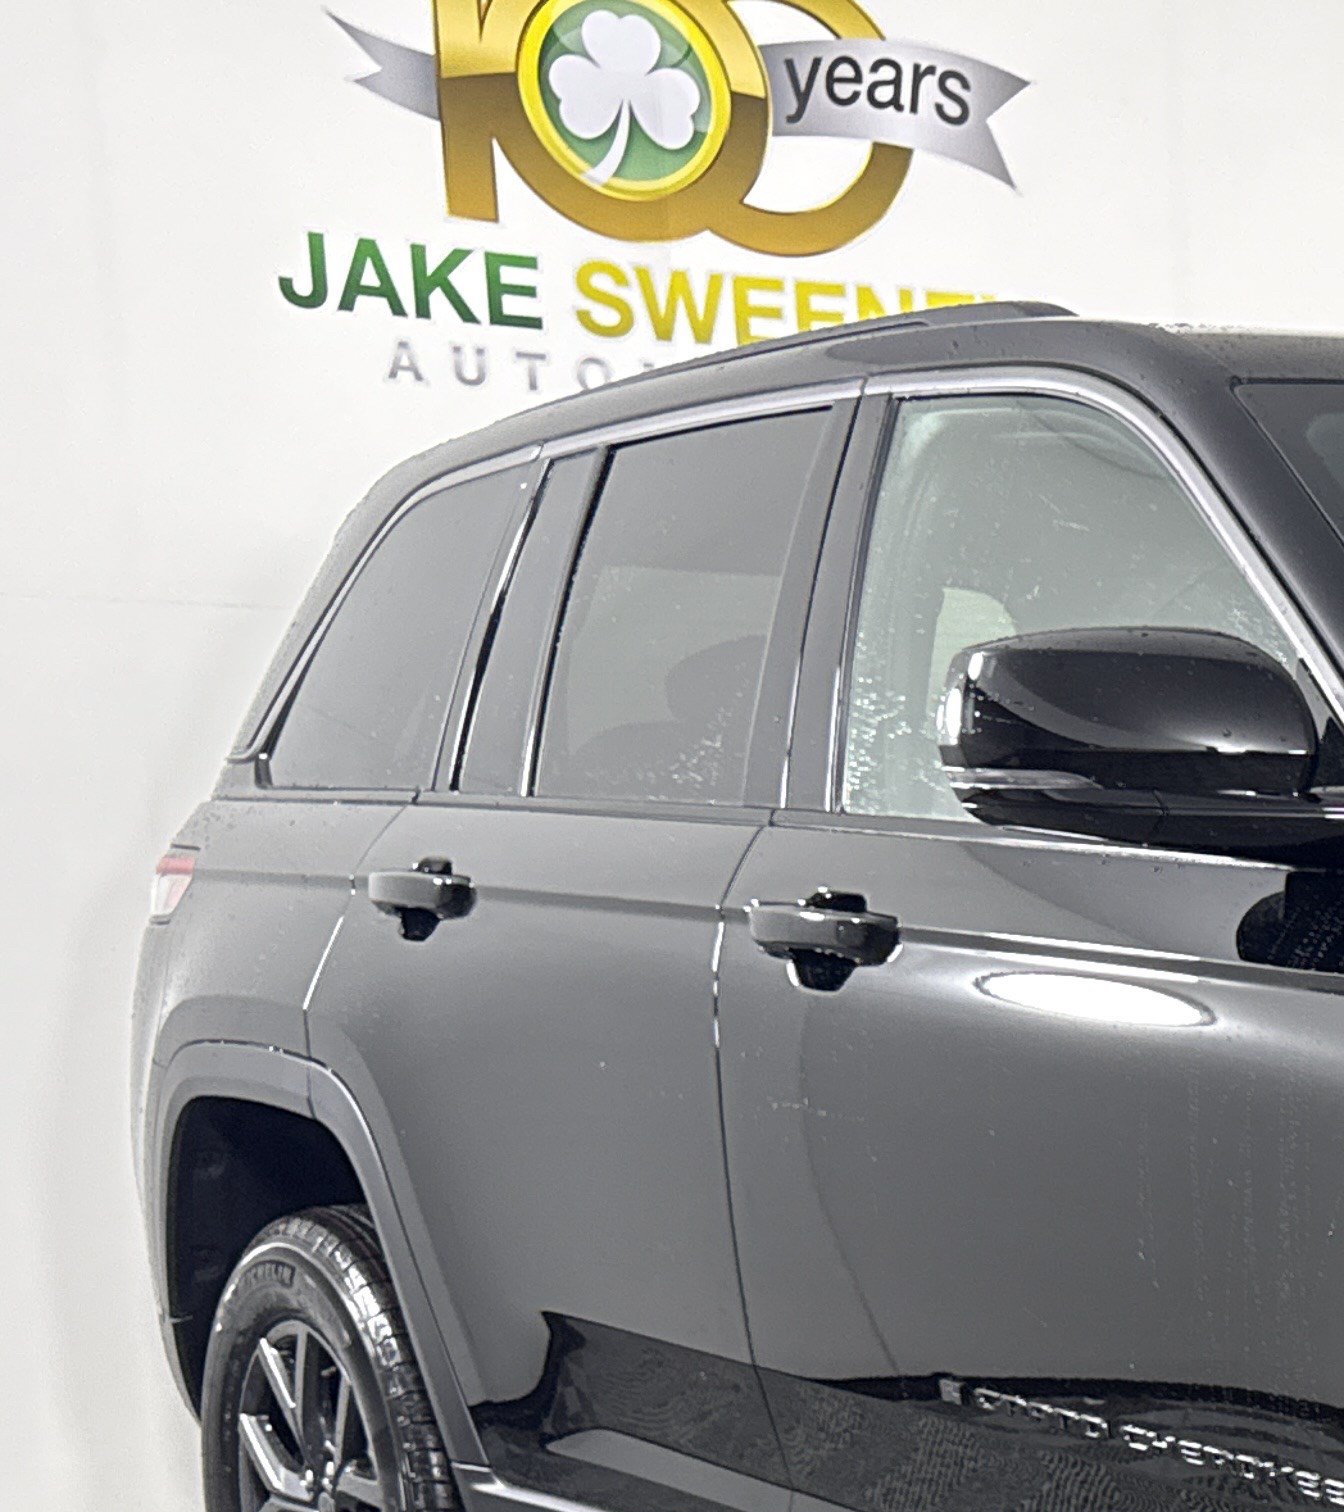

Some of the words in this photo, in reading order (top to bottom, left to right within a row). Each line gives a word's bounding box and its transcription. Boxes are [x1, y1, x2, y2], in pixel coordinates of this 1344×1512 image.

[784, 54, 972, 126] years
[279, 231, 543, 330] JAKE
[575, 260, 995, 346] SWEE
